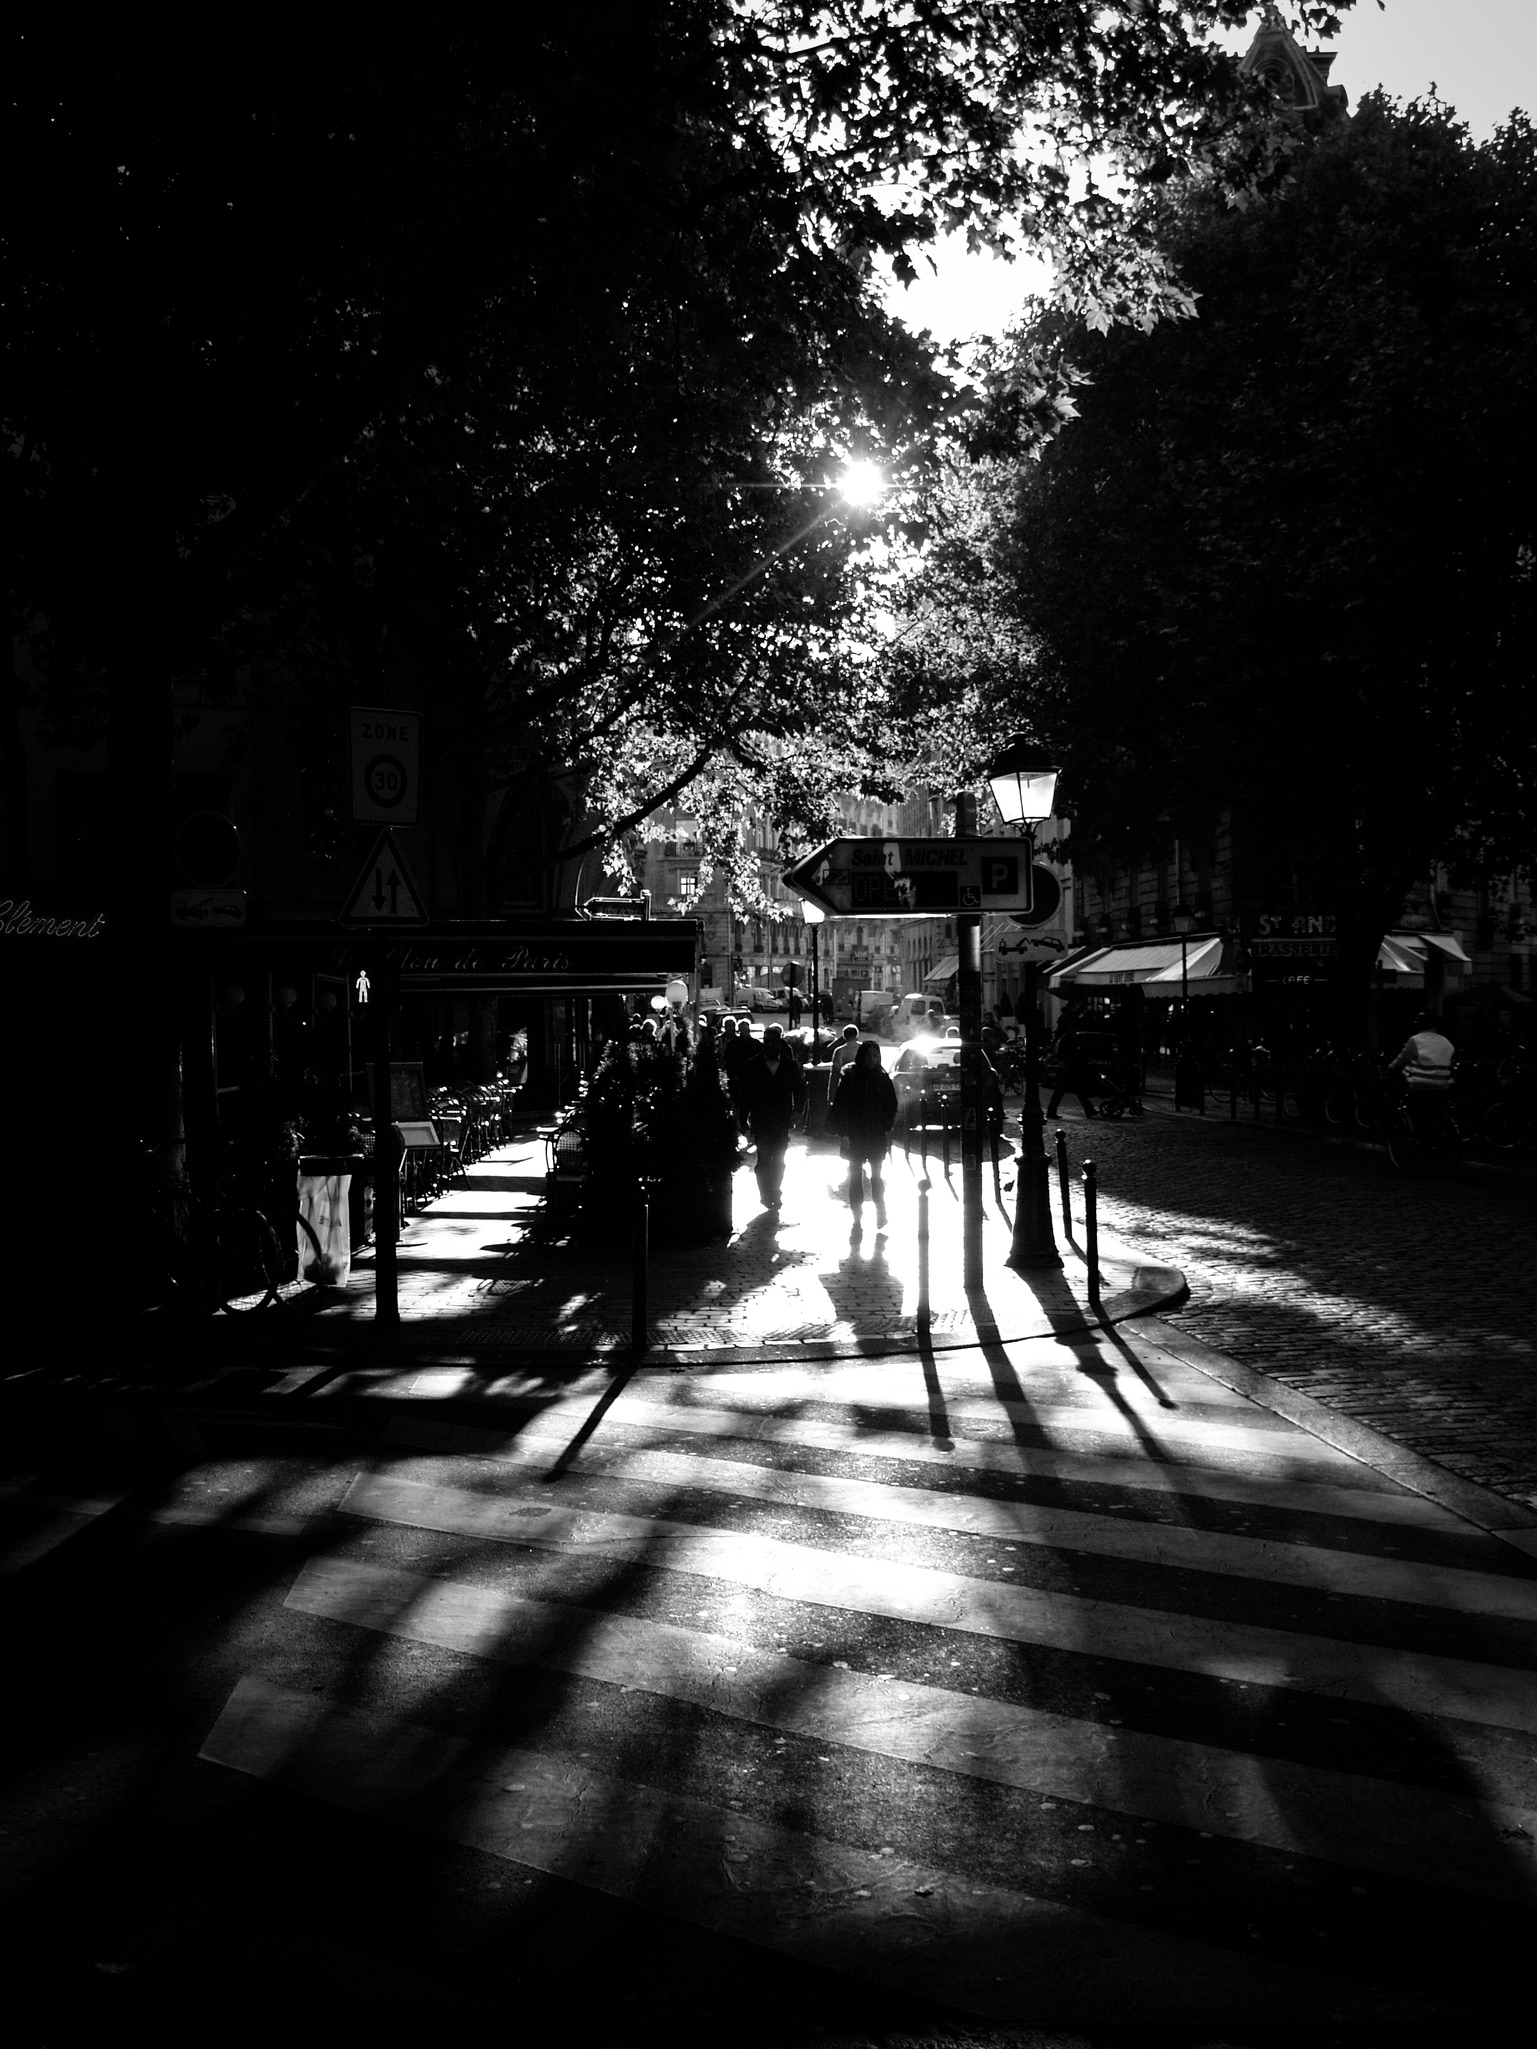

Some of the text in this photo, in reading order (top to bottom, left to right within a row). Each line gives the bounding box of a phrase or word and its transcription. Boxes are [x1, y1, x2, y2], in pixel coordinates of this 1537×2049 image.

[362, 722, 409, 743] ZONE
[374, 771, 399, 792] 30
[851, 848, 968, 867] Saint MICHEL
[991, 862, 1008, 889] P
[854, 875, 911, 902] OPE
[454, 947, 488, 970] de
[501, 944, 570, 970] Paris
[1251, 942, 1339, 957] BRASSERIE
